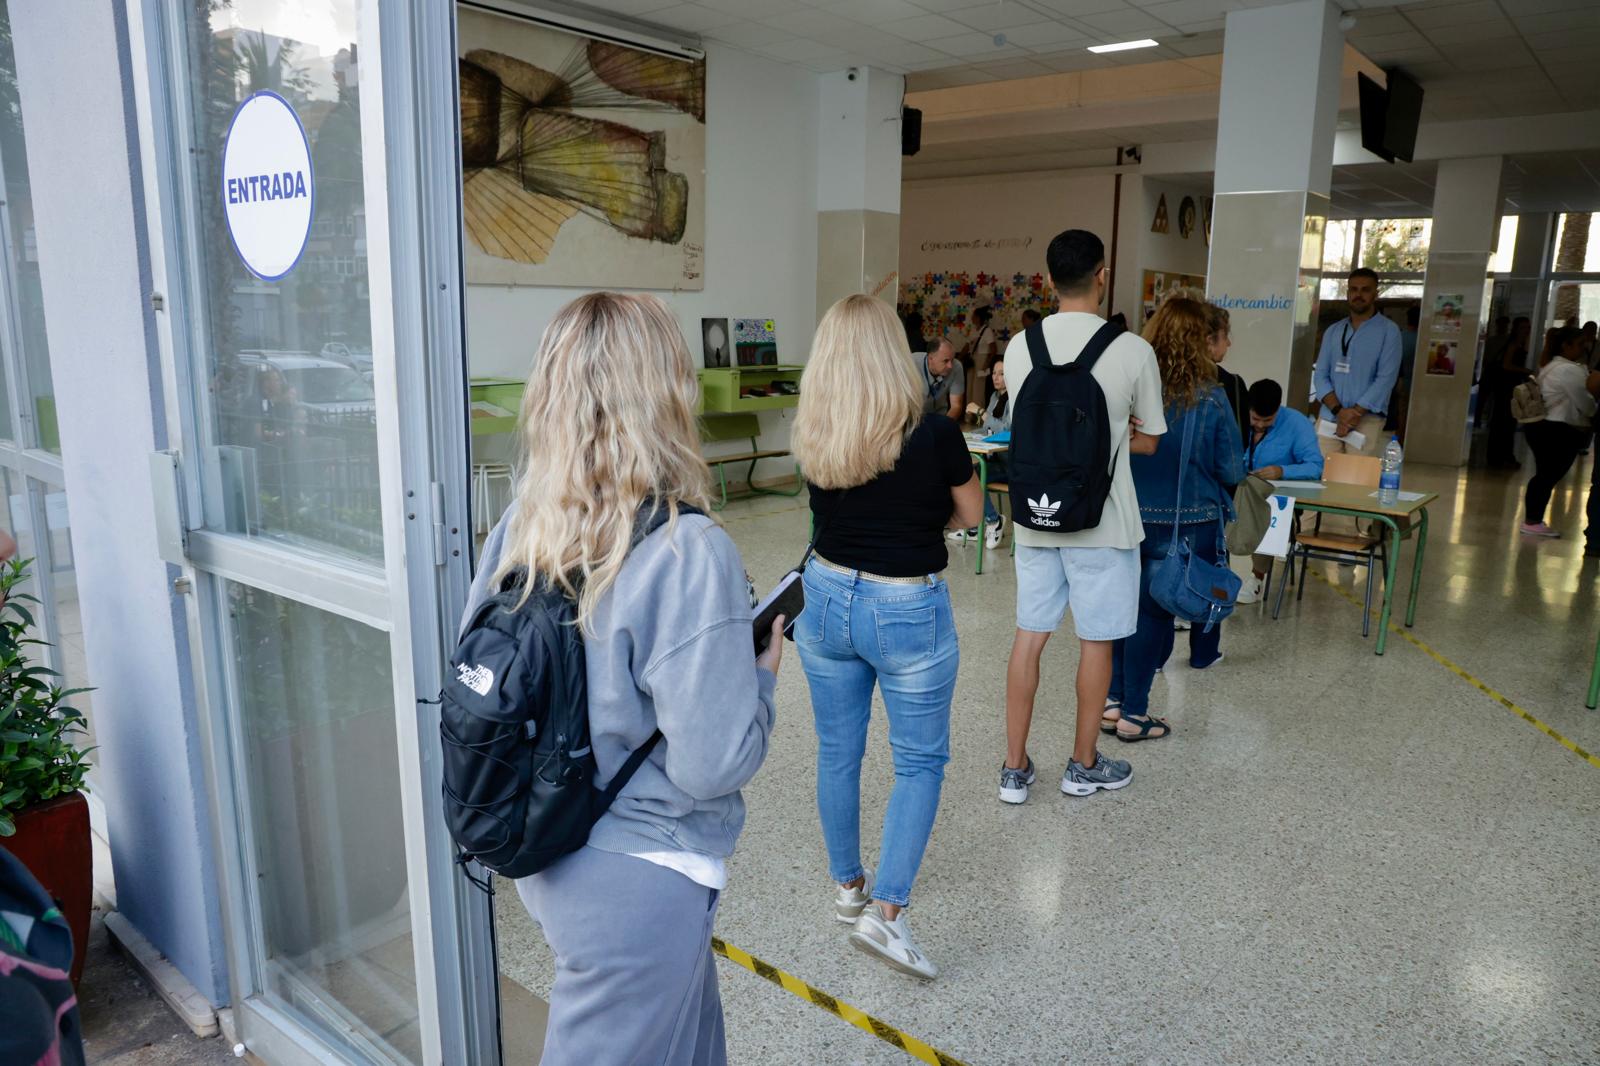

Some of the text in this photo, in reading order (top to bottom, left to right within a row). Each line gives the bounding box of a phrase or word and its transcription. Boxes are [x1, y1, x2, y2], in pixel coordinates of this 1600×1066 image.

[227, 171, 307, 204] ENTRADA
[1030, 516, 1061, 527] adidas
[1270, 516, 1278, 529] 2
[456, 662, 483, 684] NORTH
[474, 663, 490, 678] THE
[456, 673, 480, 690] FACE
